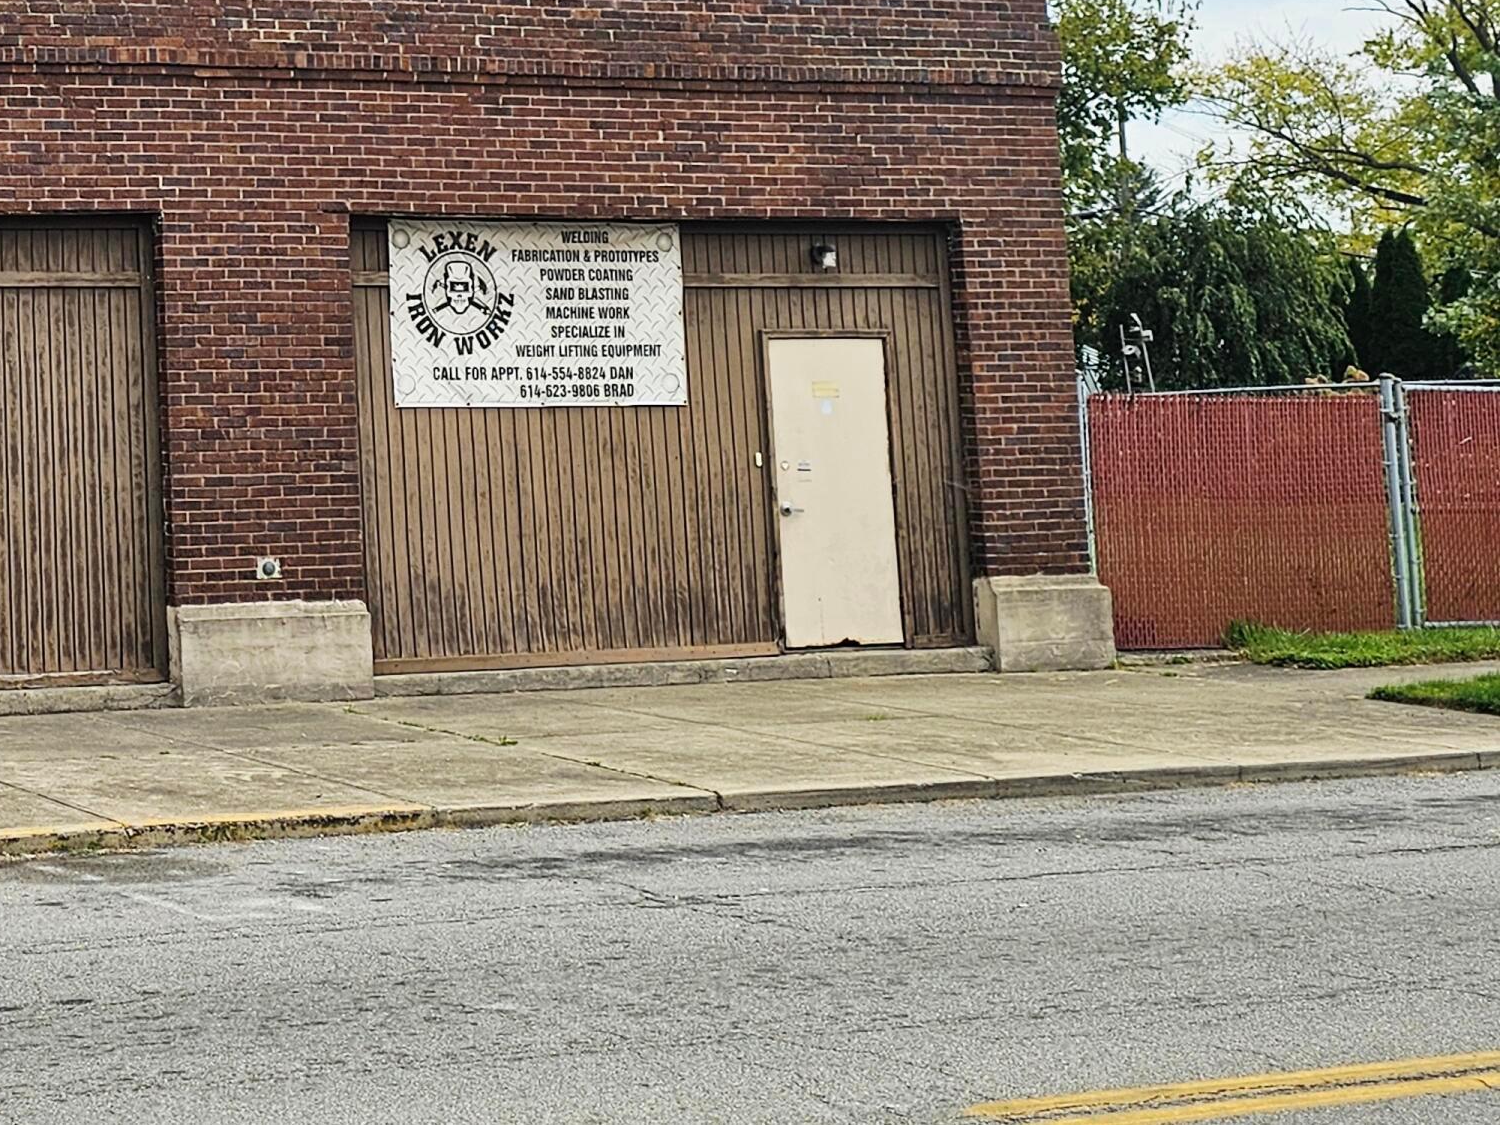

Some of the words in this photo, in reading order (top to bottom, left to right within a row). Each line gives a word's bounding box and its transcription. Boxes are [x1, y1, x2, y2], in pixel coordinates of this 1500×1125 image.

[560, 231, 610, 245] WELDING
[418, 230, 498, 263] LEXEN
[511, 249, 580, 263] FABRICATION
[583, 250, 591, 263] &
[594, 250, 660, 264] PROTOTYPES
[539, 268, 586, 282] POWDER
[588, 268, 634, 282] COATING
[545, 287, 576, 301] SAND
[578, 287, 630, 301] BLASTING
[545, 306, 595, 320] MACHINE
[597, 306, 631, 320] WORK
[405, 292, 447, 349] IRON
[453, 292, 515, 356] WORKZ
[550, 325, 611, 339] SPECIALIZE
[613, 325, 626, 338] IN
[515, 344, 556, 358] WEIGHT
[558, 344, 598, 358] LIFTING
[601, 344, 662, 358] EQUIPMENT
[433, 366, 462, 381] CALL
[464, 366, 488, 381] FOR
[491, 366, 523, 381] APPT.
[526, 366, 607, 381] 614-554-8824
[609, 366, 634, 380] DAN
[519, 383, 601, 399] 614-623-9806
[603, 383, 635, 398] BRAD
